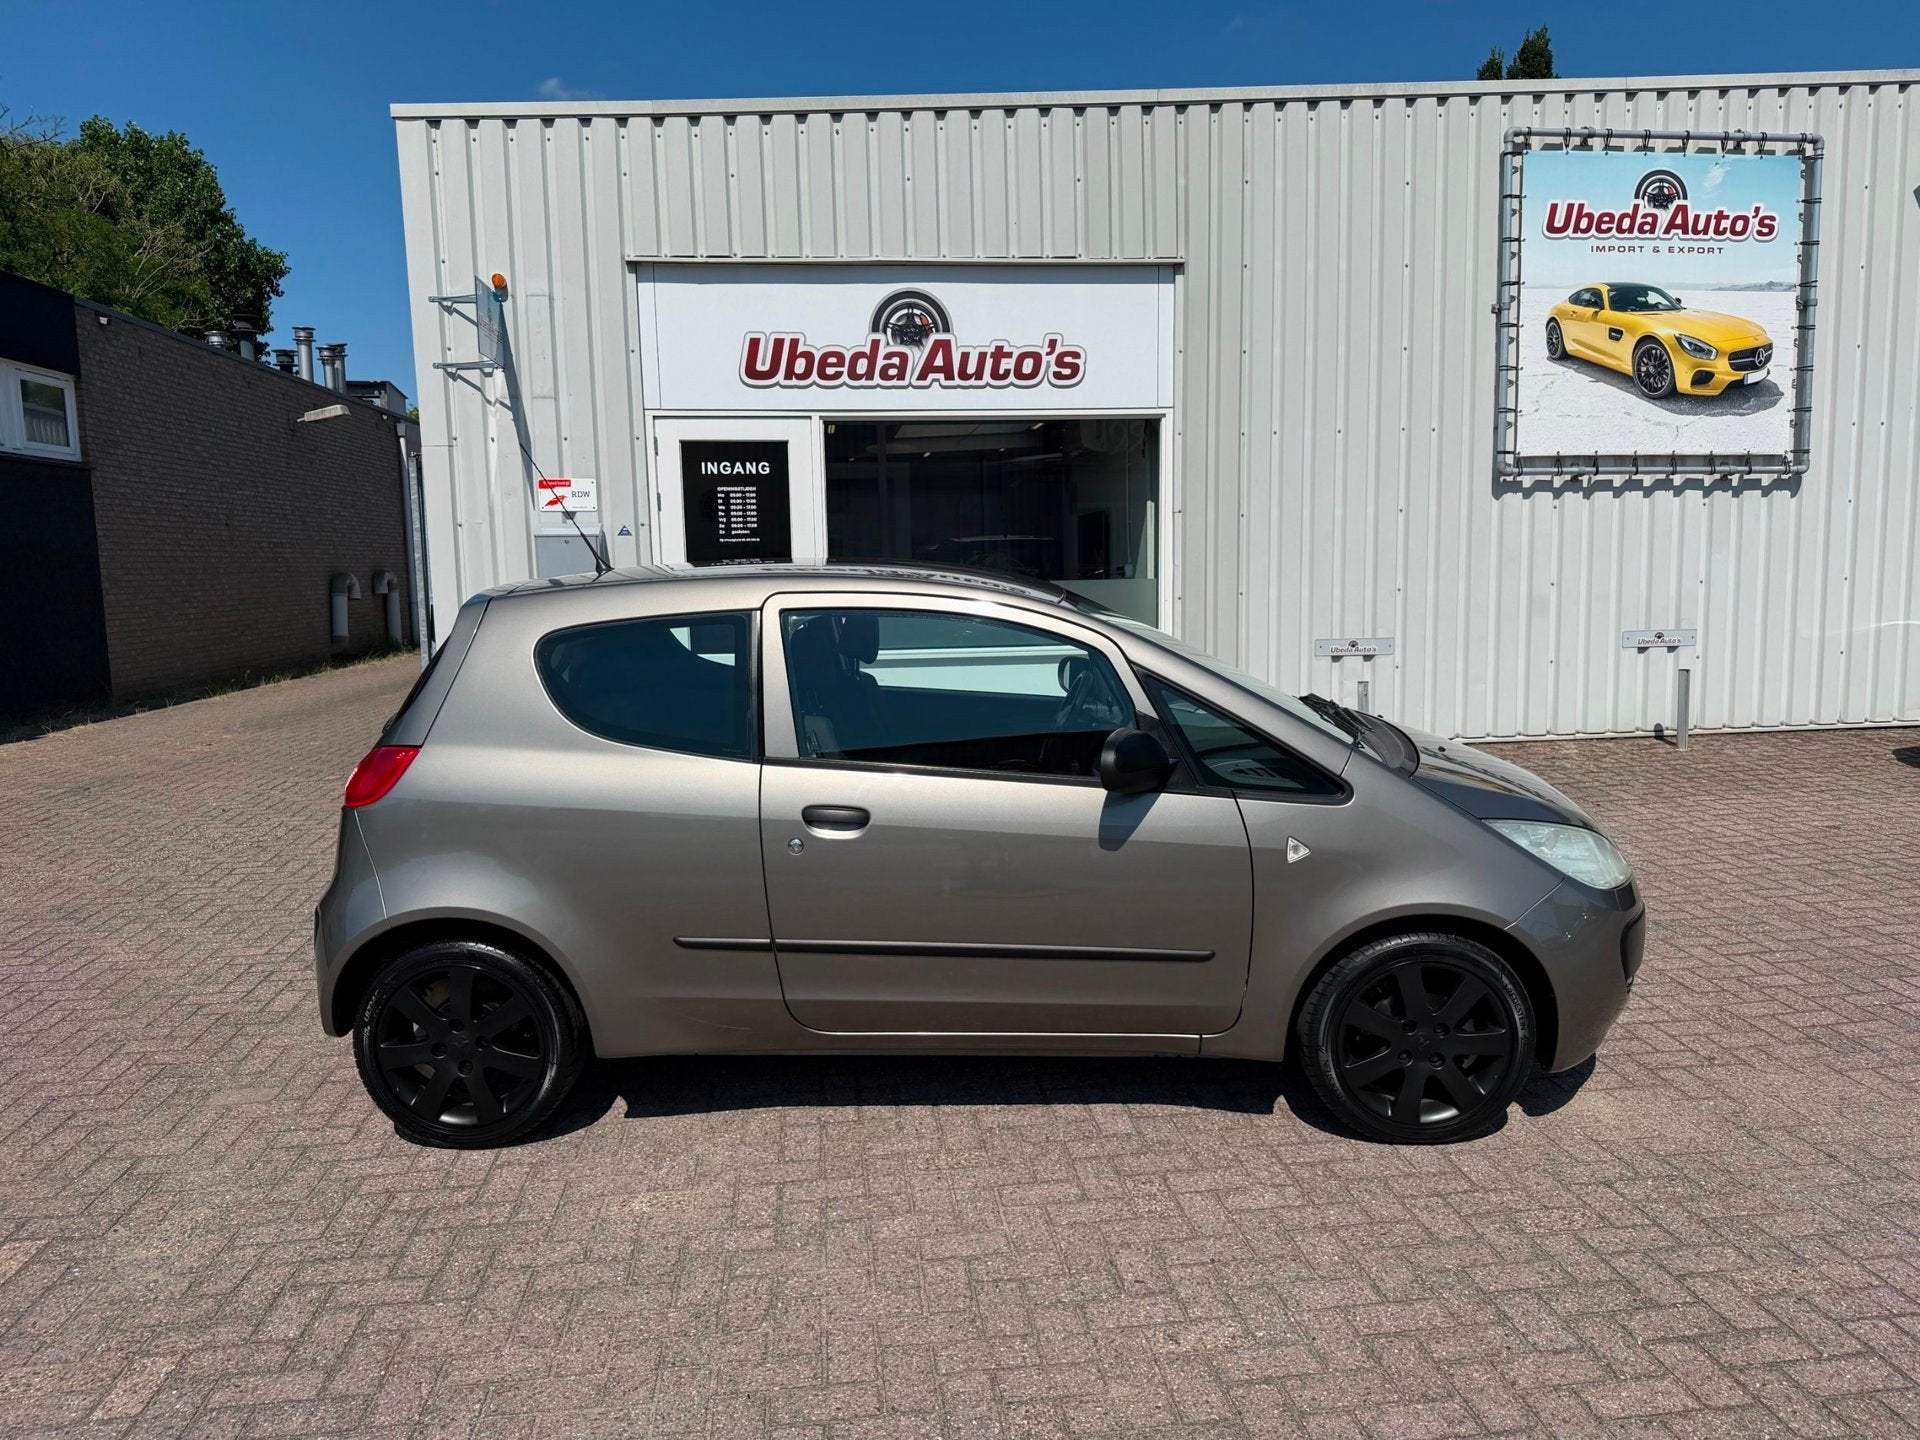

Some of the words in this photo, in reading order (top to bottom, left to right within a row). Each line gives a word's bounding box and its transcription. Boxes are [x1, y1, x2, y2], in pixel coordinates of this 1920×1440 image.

[1545, 202, 1659, 235] Ubeda
[1662, 204, 1777, 237] Auto's
[1590, 245, 1645, 253] IMPORT
[1668, 246, 1724, 254] EXPORT
[743, 336, 909, 382] Ubeda
[915, 337, 1082, 382] Auto's
[701, 461, 771, 475] INGANG
[571, 490, 590, 498] RDW
